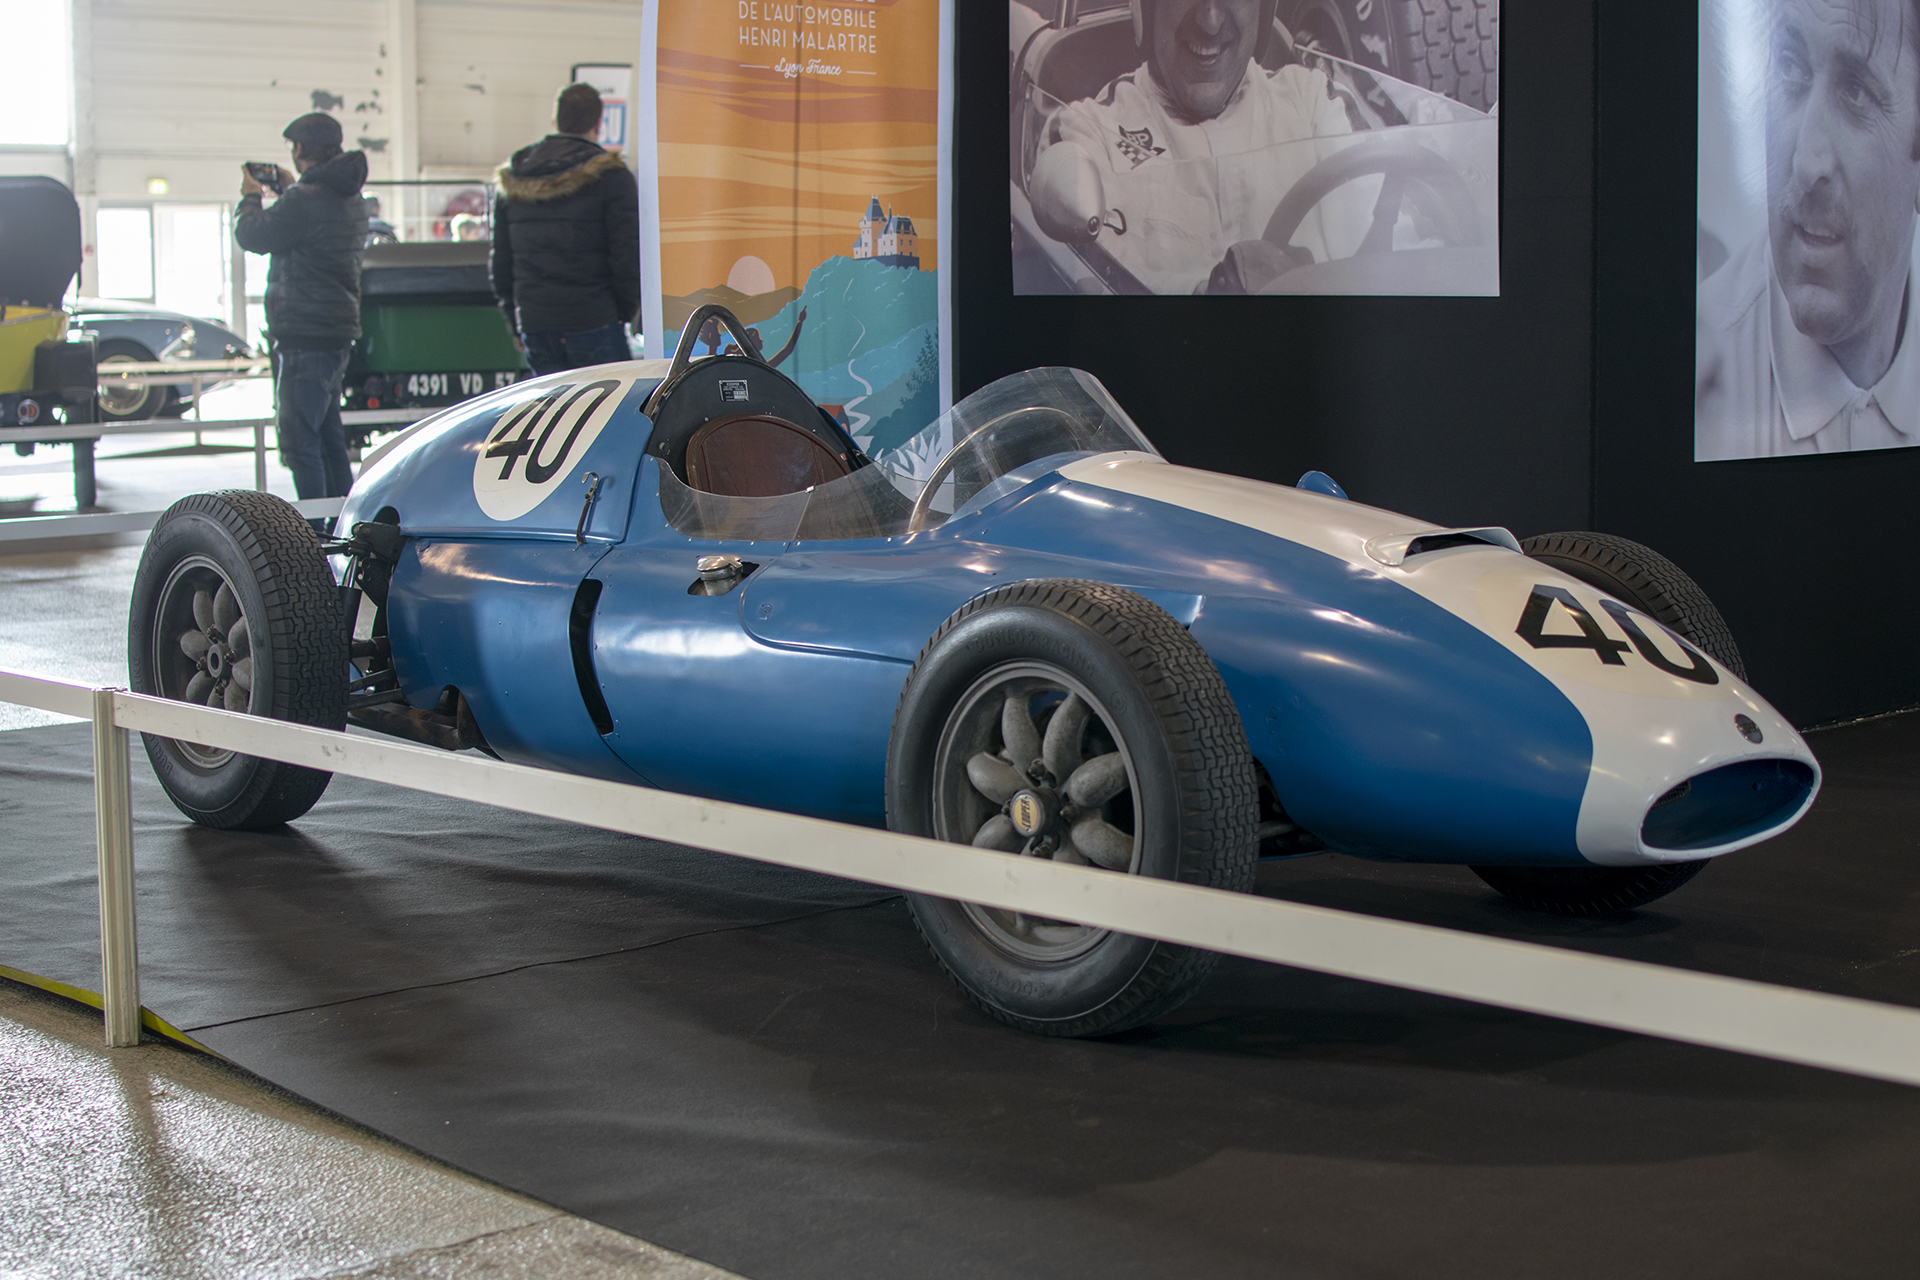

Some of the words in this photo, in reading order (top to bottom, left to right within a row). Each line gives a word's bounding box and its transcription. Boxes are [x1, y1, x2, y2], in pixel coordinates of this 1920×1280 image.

[739, 1, 758, 20] DE
[739, 26, 786, 48] HENRI
[792, 30, 876, 53] MALARTRE
[774, 57, 804, 78] Lyon
[805, 58, 842, 76] France
[407, 373, 448, 396] 4391
[460, 372, 483, 395] VD
[485, 379, 622, 485] 40
[1514, 584, 1719, 685] 40
[974, 627, 1036, 654] DUNLOP
[1040, 634, 1096, 677] RACING
[1020, 798, 1032, 829] COOPER
